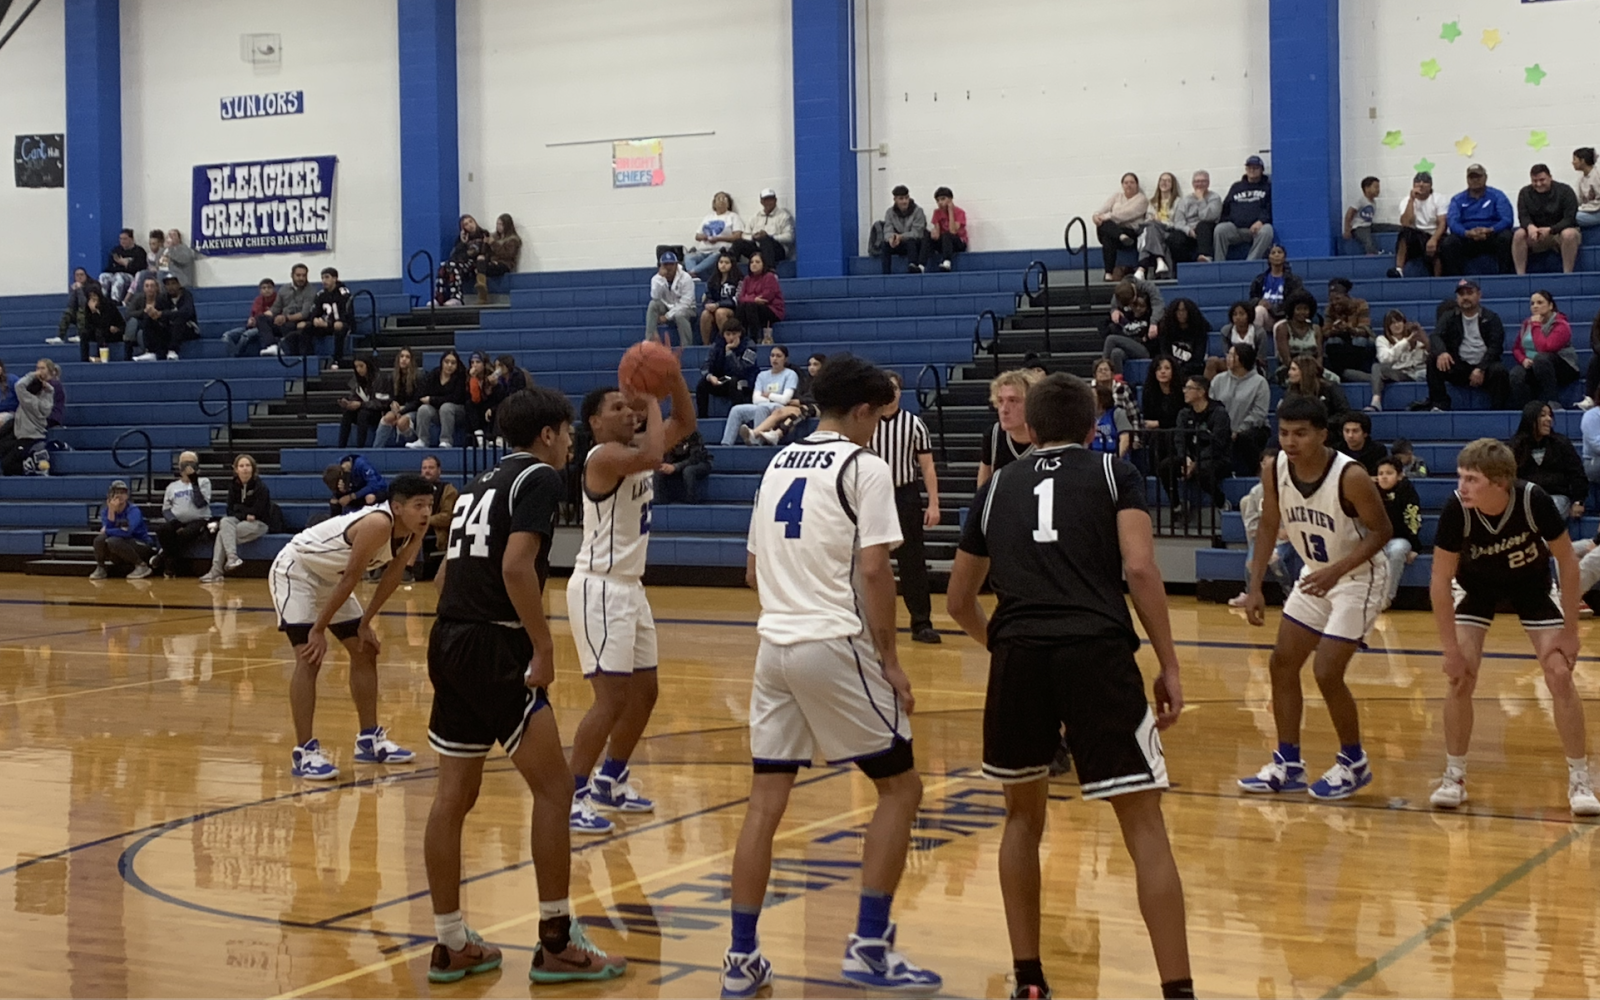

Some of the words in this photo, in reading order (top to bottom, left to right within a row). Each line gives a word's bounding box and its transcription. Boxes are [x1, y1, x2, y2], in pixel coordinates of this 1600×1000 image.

[221, 91, 298, 119] JUNIORS
[207, 161, 321, 201] BLEACHER
[616, 170, 653, 183] CHIEFS
[201, 197, 330, 237] CREATURES
[195, 238, 243, 250] LAKEVIEW
[245, 236, 276, 247] CHIEFS
[774, 451, 836, 469] CHIEFS
[774, 477, 807, 539] 4
[1033, 478, 1058, 542] 1
[447, 489, 497, 560] 24
[1301, 531, 1329, 563] 13
[1508, 542, 1539, 569] 23
